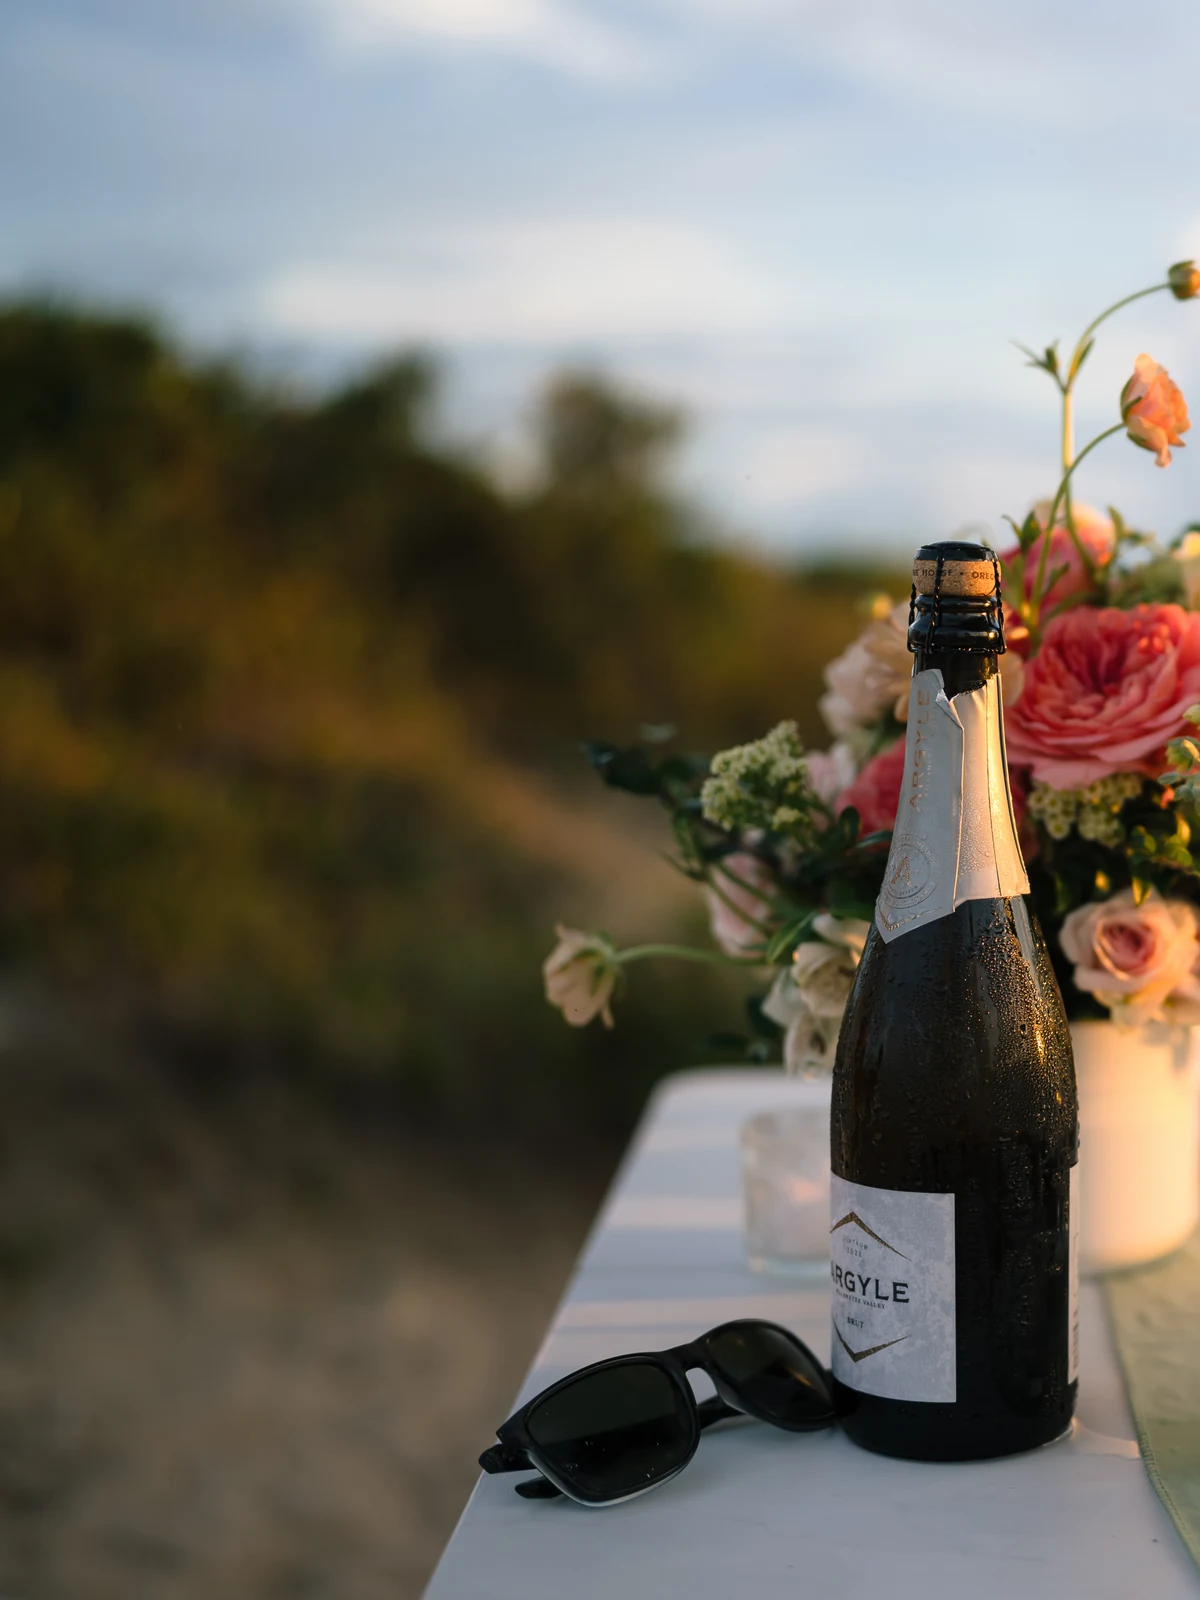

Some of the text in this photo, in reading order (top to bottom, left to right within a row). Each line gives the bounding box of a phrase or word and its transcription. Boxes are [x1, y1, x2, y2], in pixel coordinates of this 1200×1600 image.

[922, 569, 953, 577] HOSE
[972, 571, 995, 580] OREG
[909, 690, 930, 812] ARGYLE
[846, 1247, 862, 1258] 2022
[863, 1299, 886, 1309] VALLEY
[847, 1316, 864, 1328] BRUT
